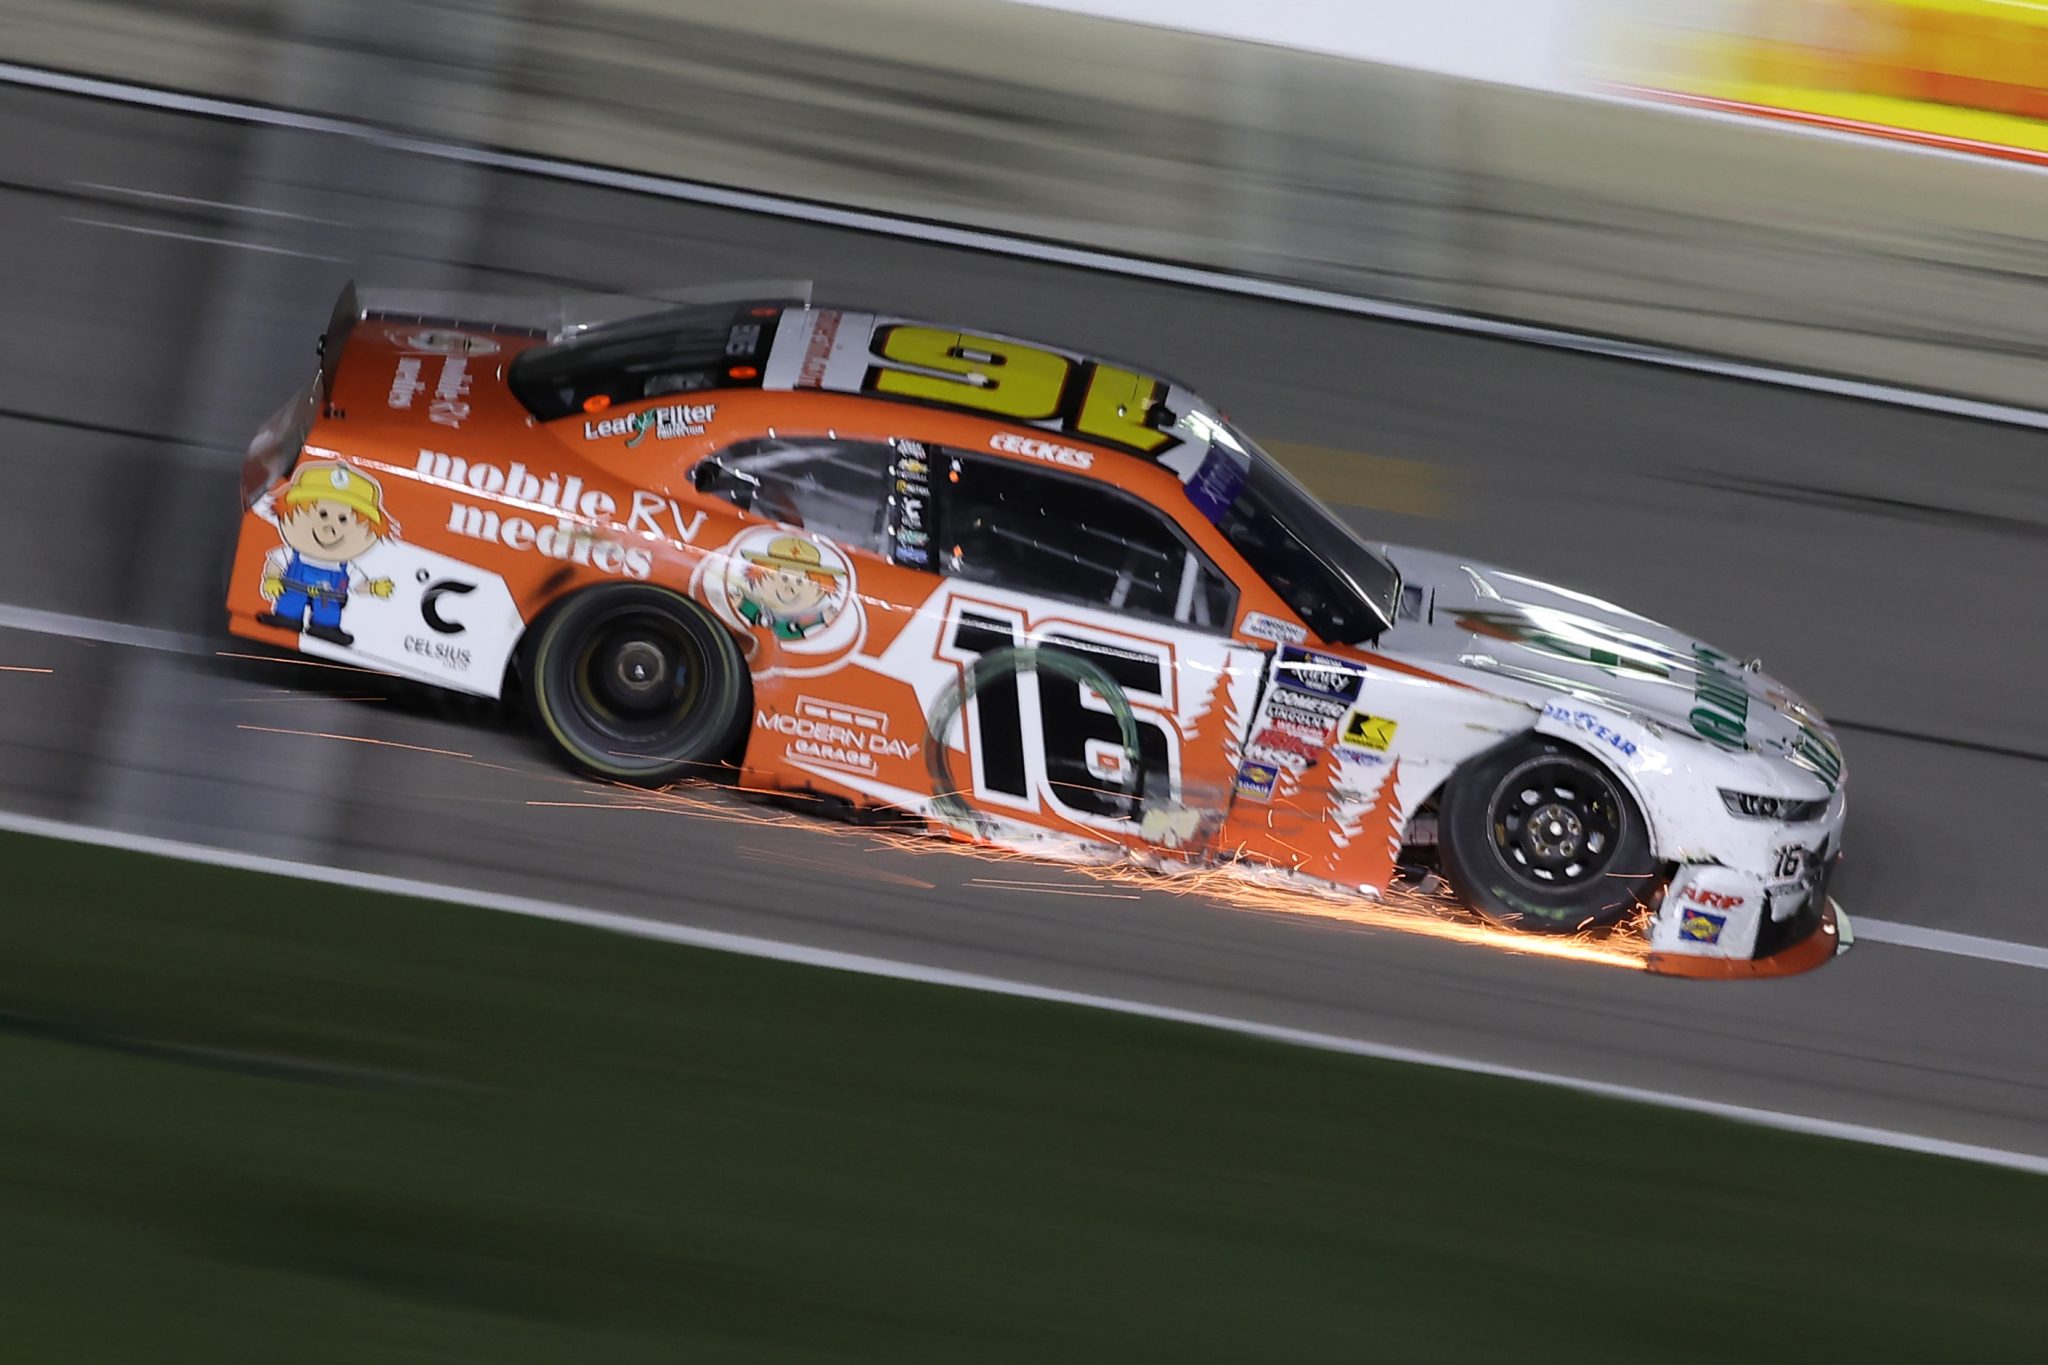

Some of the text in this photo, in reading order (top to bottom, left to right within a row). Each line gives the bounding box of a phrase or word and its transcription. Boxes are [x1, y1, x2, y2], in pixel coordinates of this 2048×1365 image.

[584, 403, 717, 441] Leaf Filter
[416, 448, 709, 543] mobile RV
[446, 501, 652, 580] medics
[403, 634, 472, 664] CELSIUS
[756, 709, 921, 761] MODERN DAY
[953, 608, 1175, 827] 16
[795, 739, 873, 768] GARAGE
